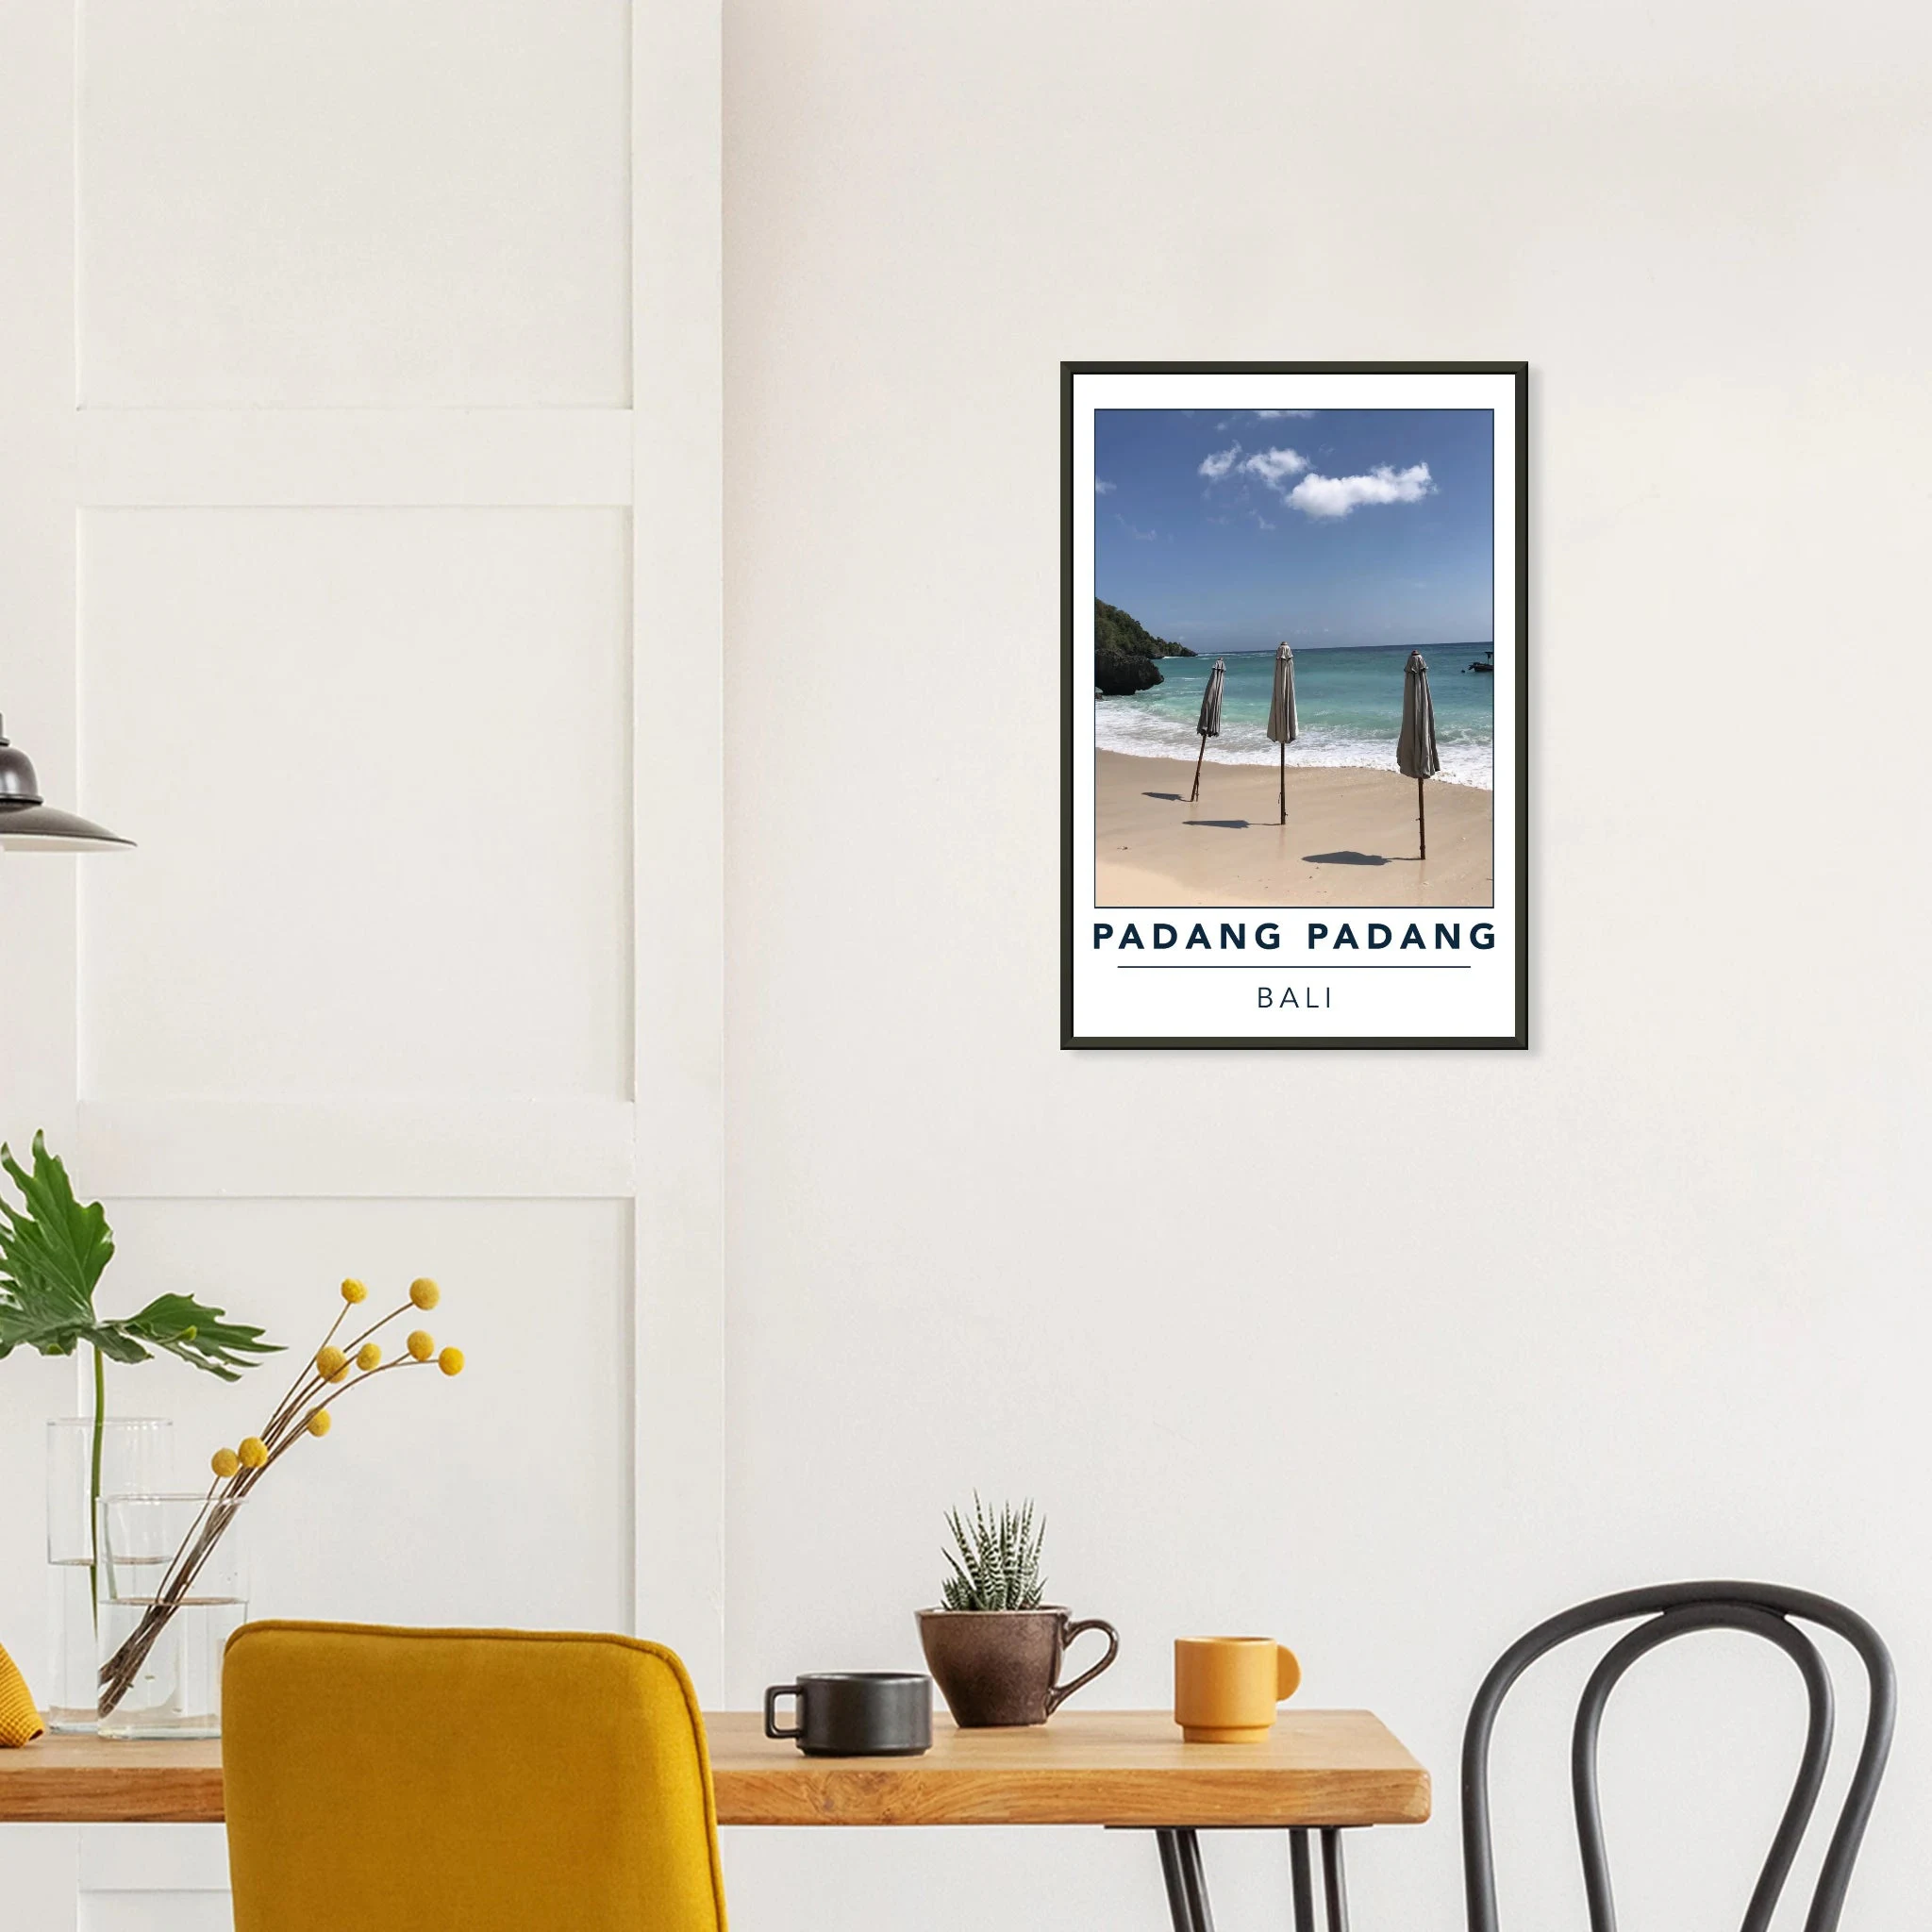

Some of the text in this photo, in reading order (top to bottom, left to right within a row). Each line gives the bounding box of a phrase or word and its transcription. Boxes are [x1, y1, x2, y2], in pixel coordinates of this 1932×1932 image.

[1093, 922, 1496, 950] PADANG PADANG
[1257, 987, 1331, 1008] BALI
